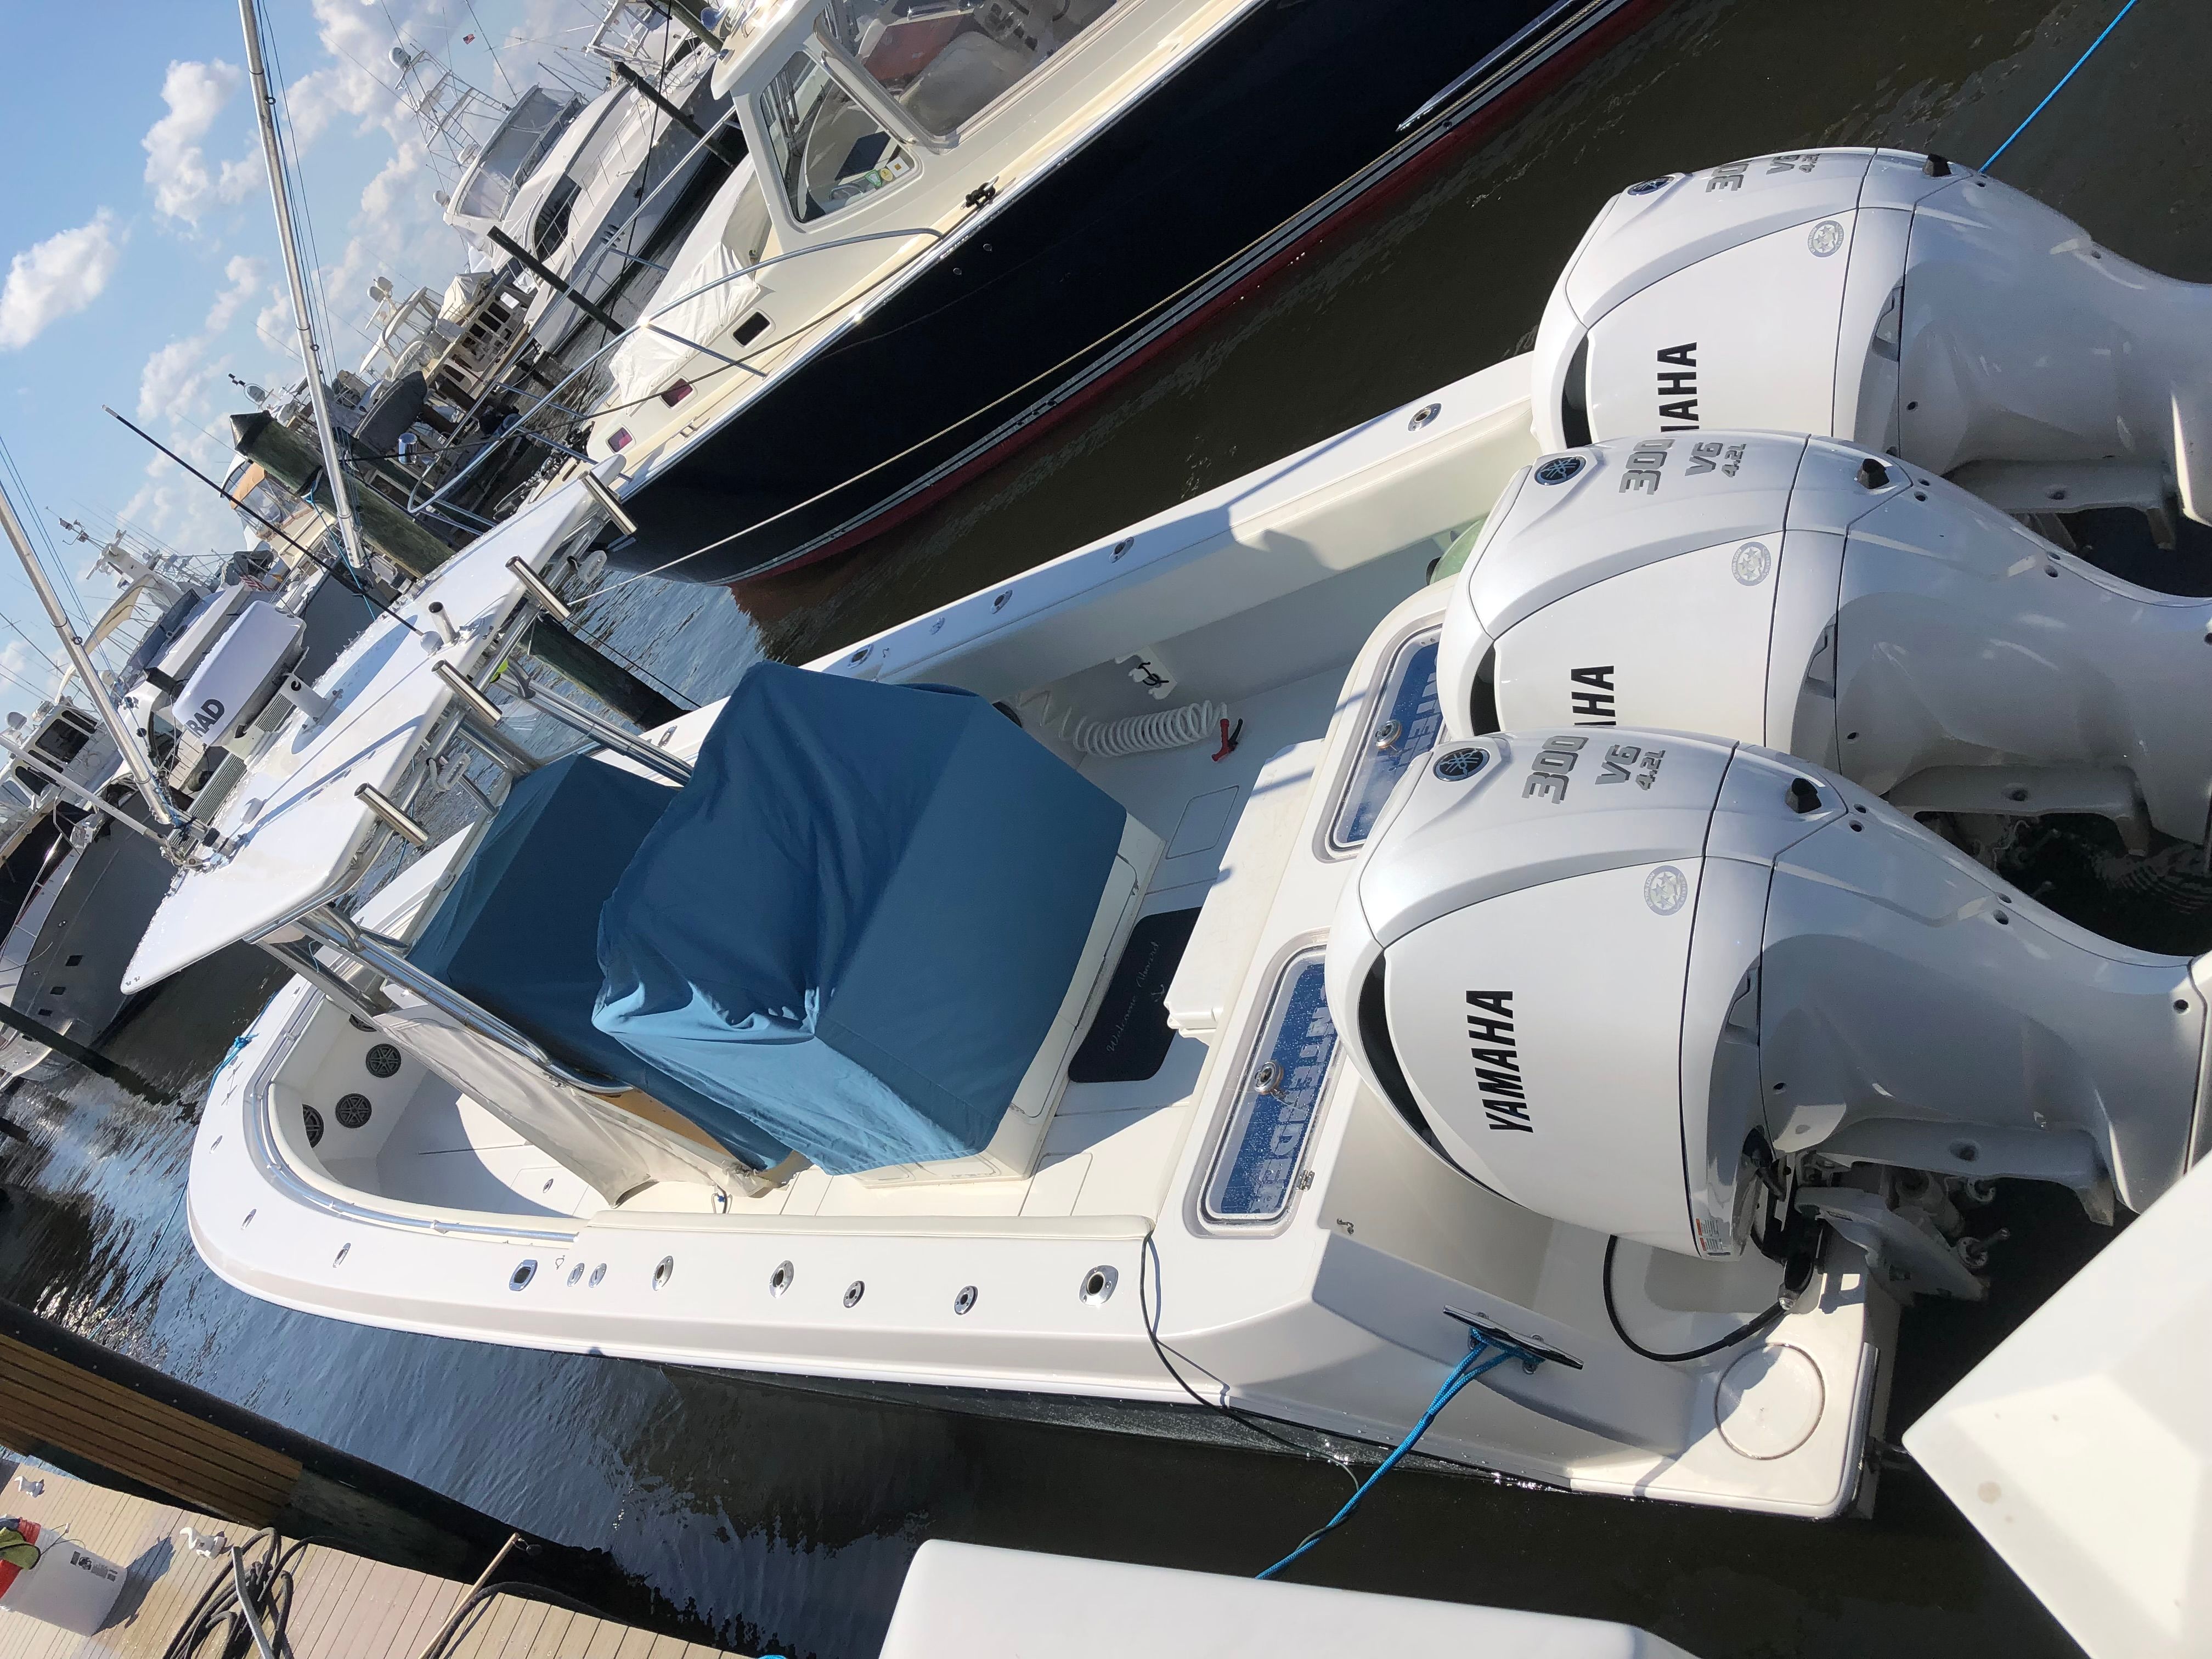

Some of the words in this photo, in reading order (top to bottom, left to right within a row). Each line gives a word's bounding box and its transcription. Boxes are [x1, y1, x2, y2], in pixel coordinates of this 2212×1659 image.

[1705, 160, 1752, 193] 30
[1657, 342, 1700, 432] AHA
[1618, 438, 1675, 495] 300
[1685, 442, 1724, 476] V6
[1721, 443, 1747, 477] 4.2L
[184, 698, 225, 738] RAD
[1571, 665, 1617, 725] HA
[1521, 735, 1589, 805] 300
[1595, 744, 1641, 785] V6
[1635, 750, 1666, 791] 4.2L
[1106, 995, 1136, 1052] Welcome
[1466, 990, 1534, 1133] YAMAHA
[1249, 985, 1335, 1214] NTENDER
